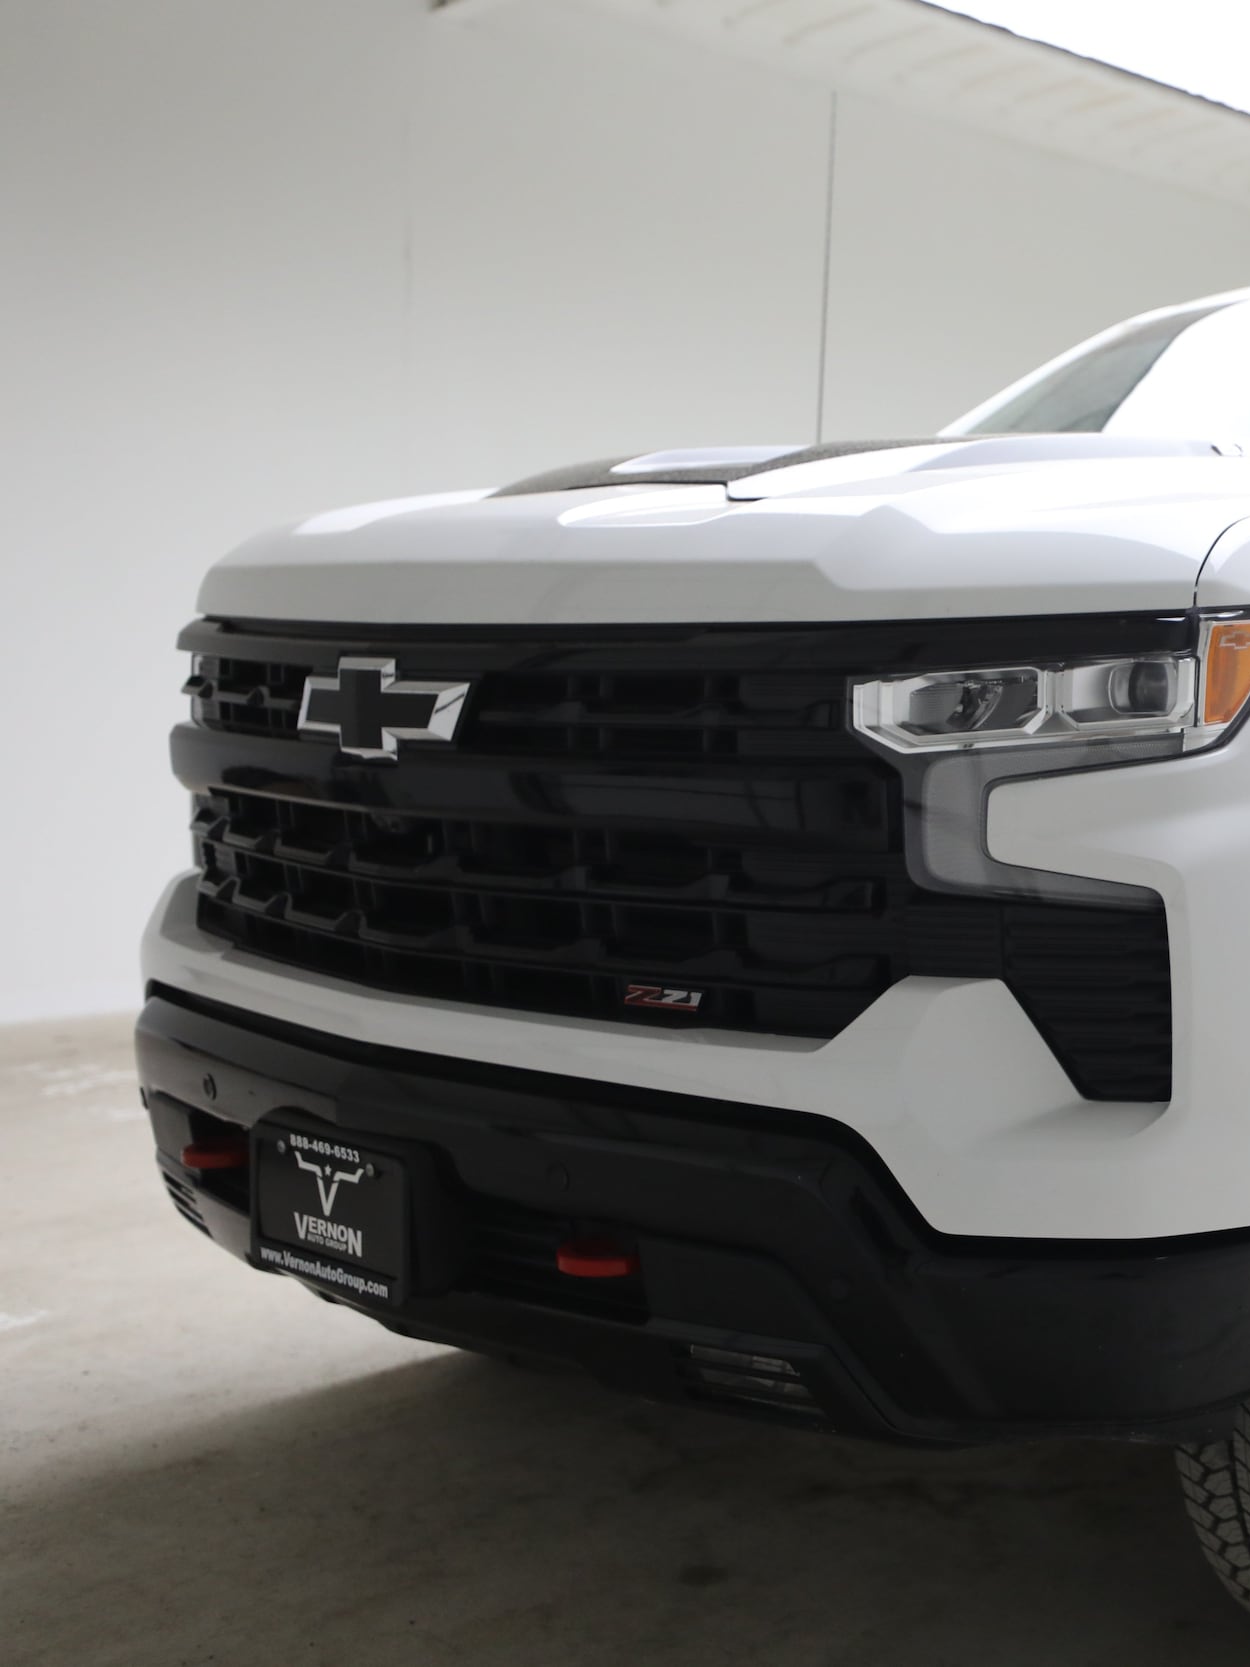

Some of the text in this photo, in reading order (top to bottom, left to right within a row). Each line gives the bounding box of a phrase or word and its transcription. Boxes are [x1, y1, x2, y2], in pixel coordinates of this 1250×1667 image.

[624, 984, 702, 1011] Z71
[289, 1133, 360, 1163] 888-469-6533
[293, 1211, 362, 1258] VERNON
[307, 1233, 348, 1251] AUTO GROUP
[260, 1247, 388, 1298] www.VernonAutoGroup.com
